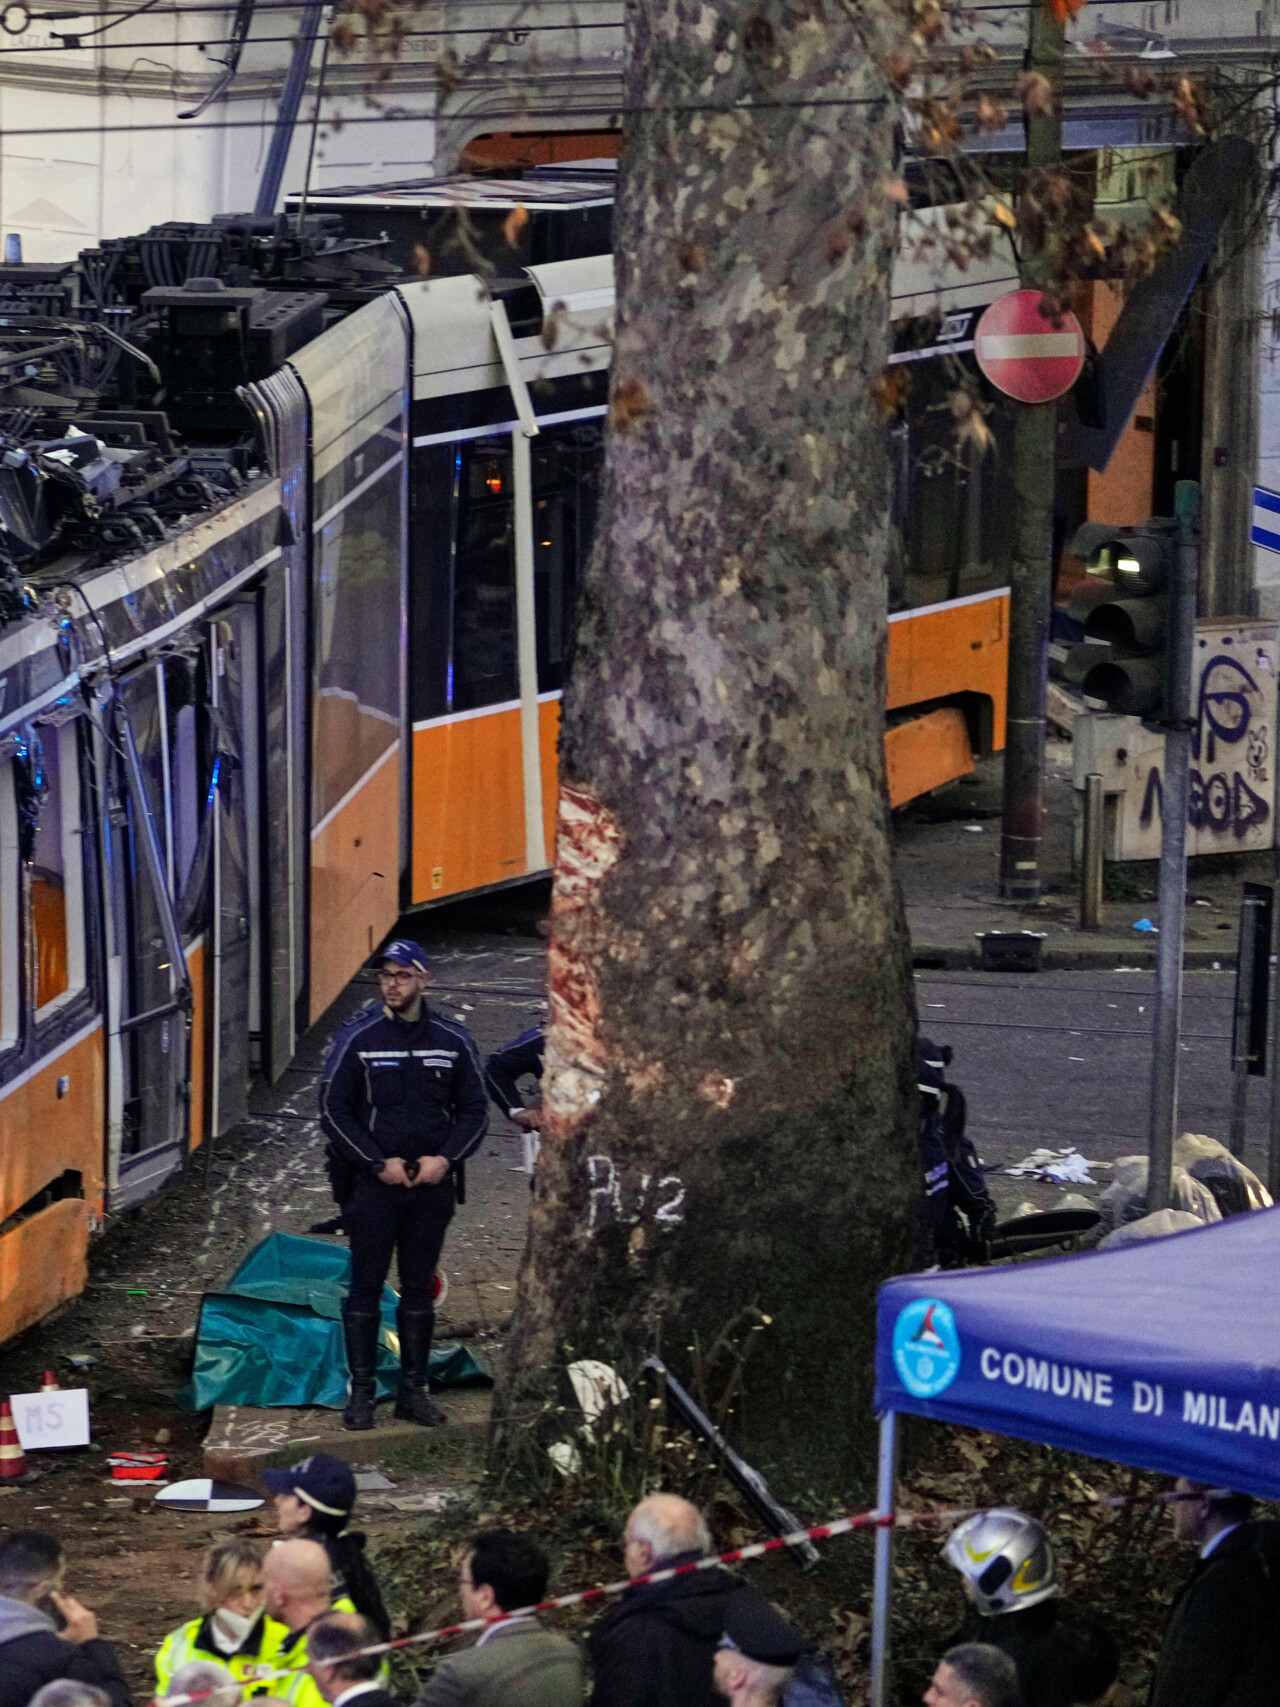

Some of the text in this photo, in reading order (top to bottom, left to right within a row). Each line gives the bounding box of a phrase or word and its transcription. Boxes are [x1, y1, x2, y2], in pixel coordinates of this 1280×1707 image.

[981, 1347, 1113, 1407] COMUNE
[1133, 1381, 1163, 1416] DI
[1183, 1390, 1280, 1440] MILAN
